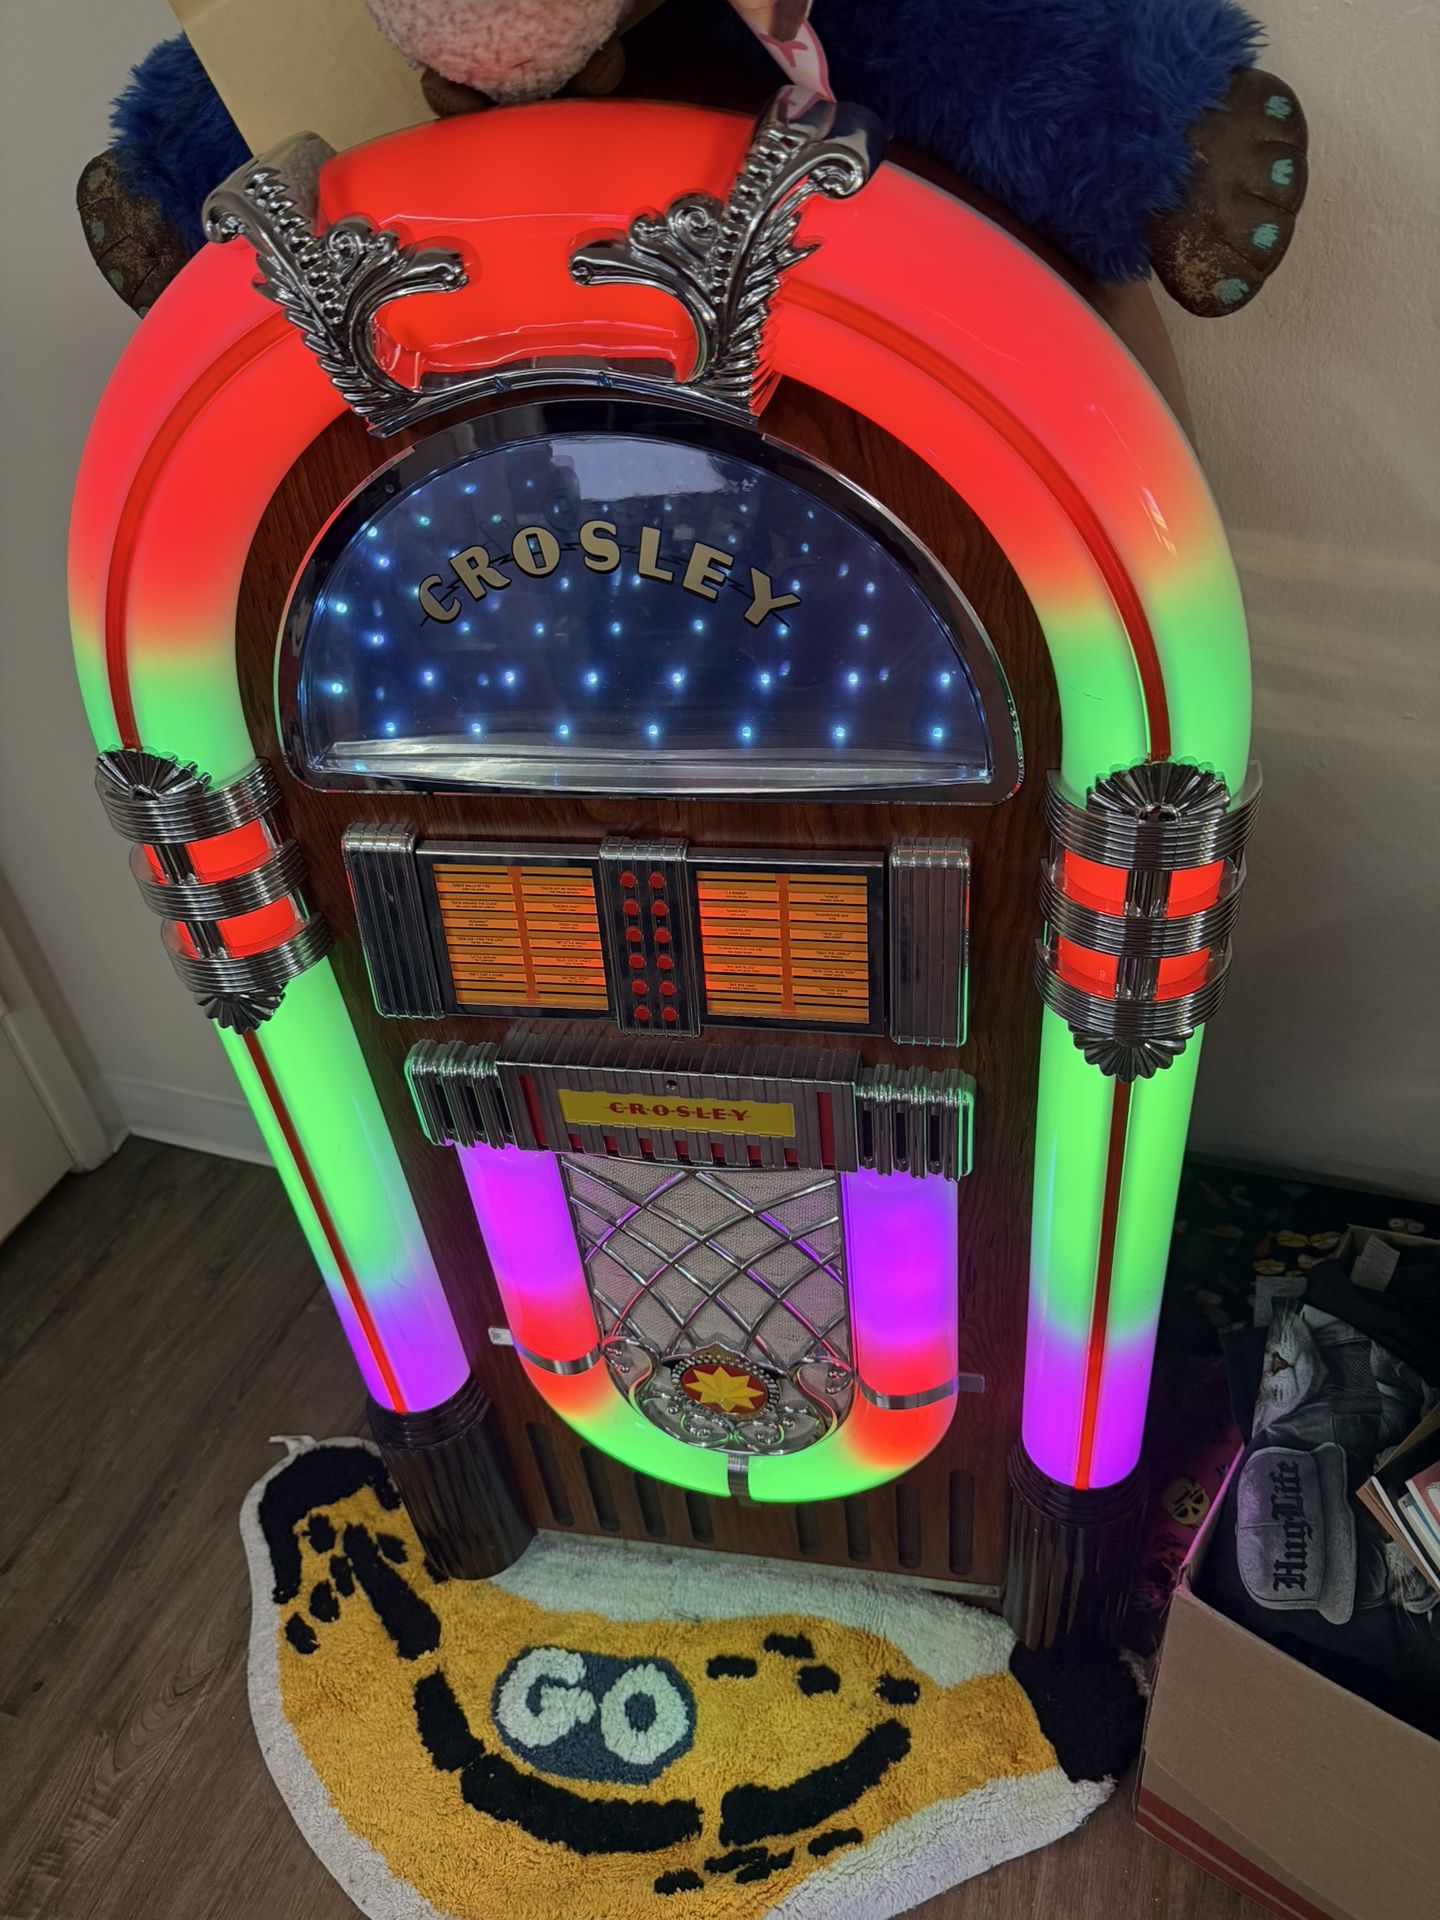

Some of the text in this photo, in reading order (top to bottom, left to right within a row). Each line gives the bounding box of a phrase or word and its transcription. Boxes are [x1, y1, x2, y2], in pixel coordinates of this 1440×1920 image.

[418, 519, 801, 628] CROSLEY
[609, 1101, 749, 1122] CROSLEY
[496, 1647, 690, 1766] GO
